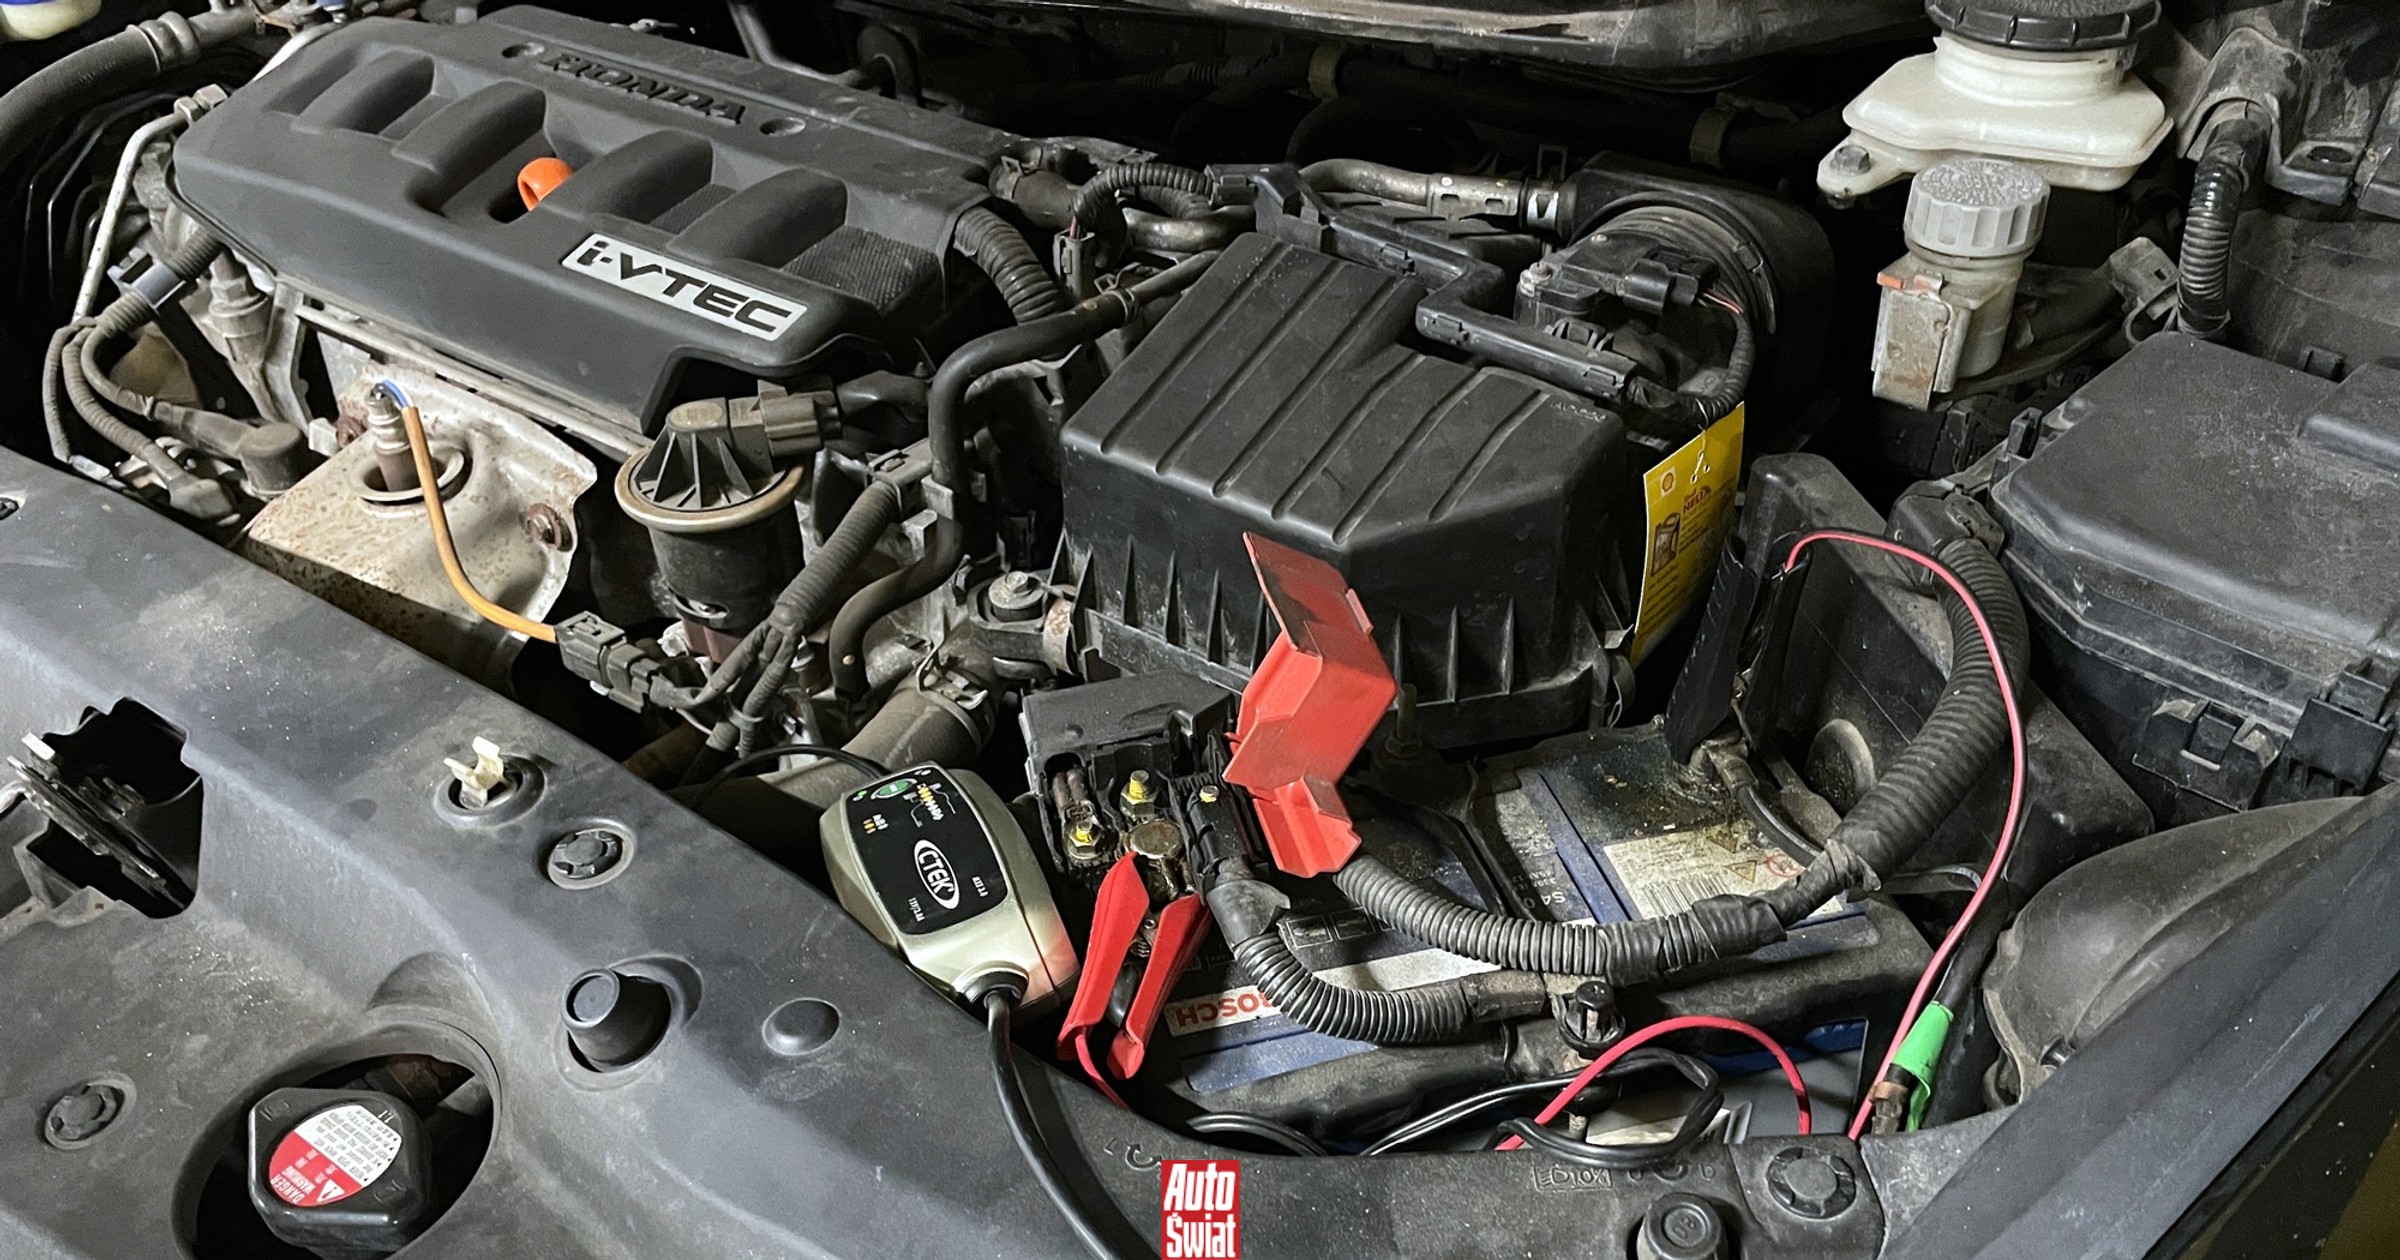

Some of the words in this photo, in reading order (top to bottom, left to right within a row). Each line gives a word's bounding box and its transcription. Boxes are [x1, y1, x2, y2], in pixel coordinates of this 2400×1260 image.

[541, 53, 746, 125] HONDA
[576, 240, 792, 334] i-VTEC
[918, 850, 955, 895] CTEK
[270, 1174, 306, 1205] DANGER
